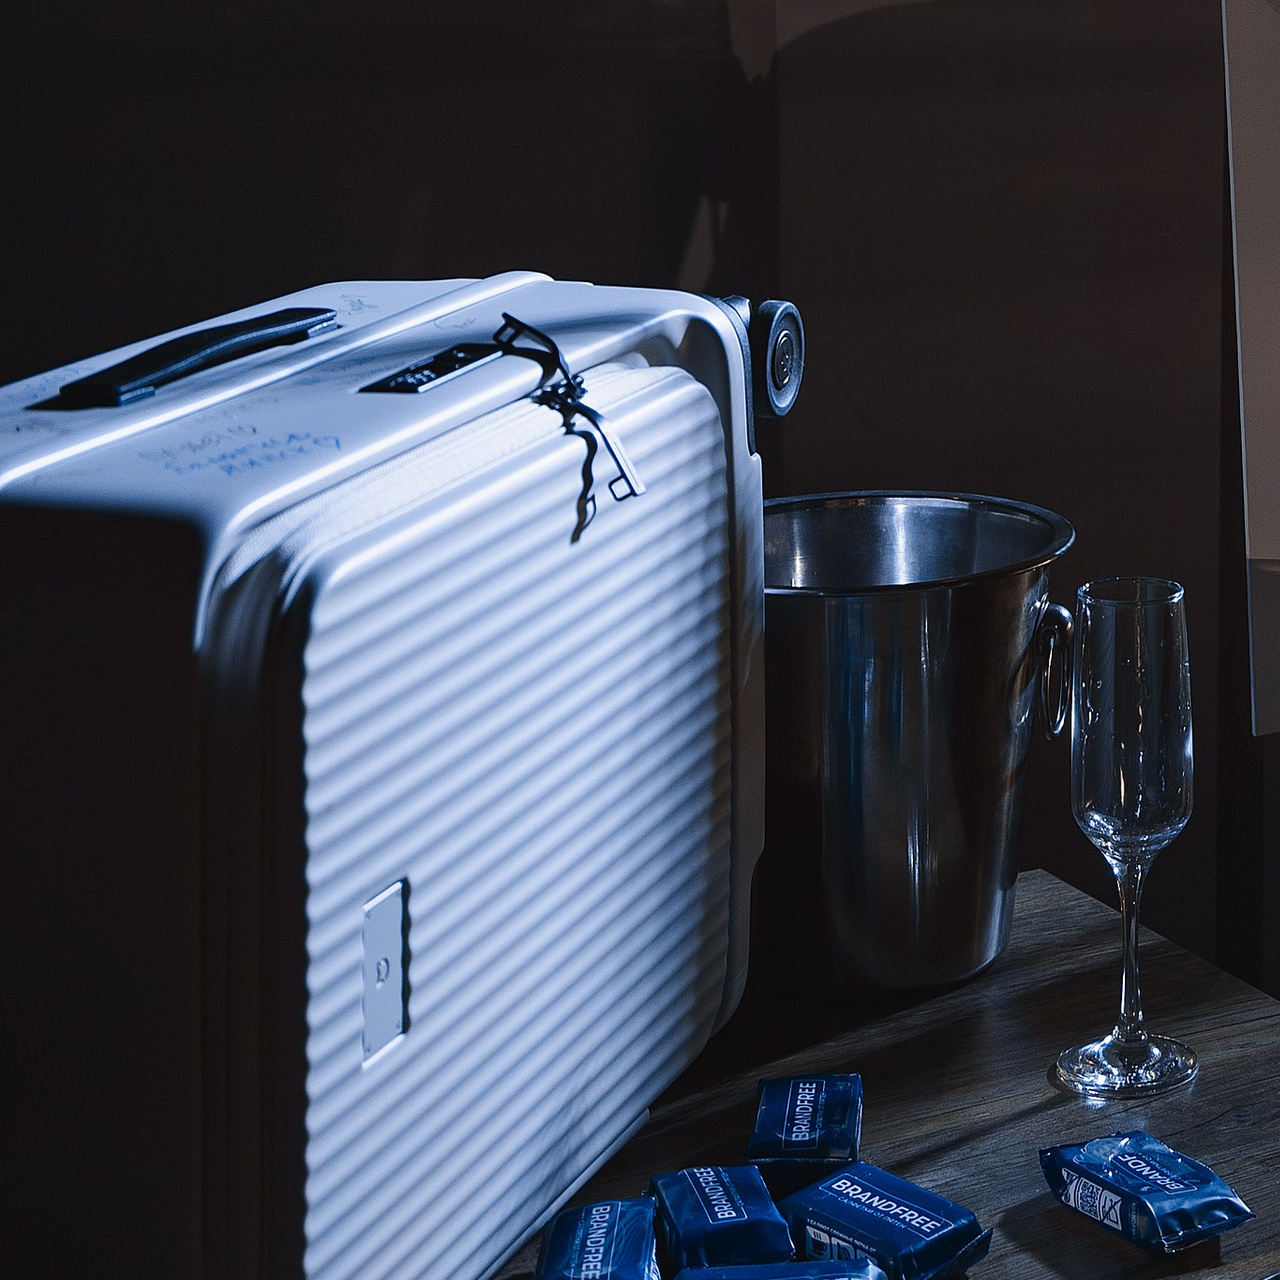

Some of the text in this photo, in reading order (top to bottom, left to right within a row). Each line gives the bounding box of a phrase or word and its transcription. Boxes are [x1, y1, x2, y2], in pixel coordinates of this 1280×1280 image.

[792, 1082, 817, 1141] BRANDFREE
[694, 1167, 737, 1219] BRANDFREE
[1117, 1153, 1185, 1190] BRANDF
[831, 1178, 942, 1234] BRANDFREE
[581, 1205, 611, 1280] BRANDFREE
